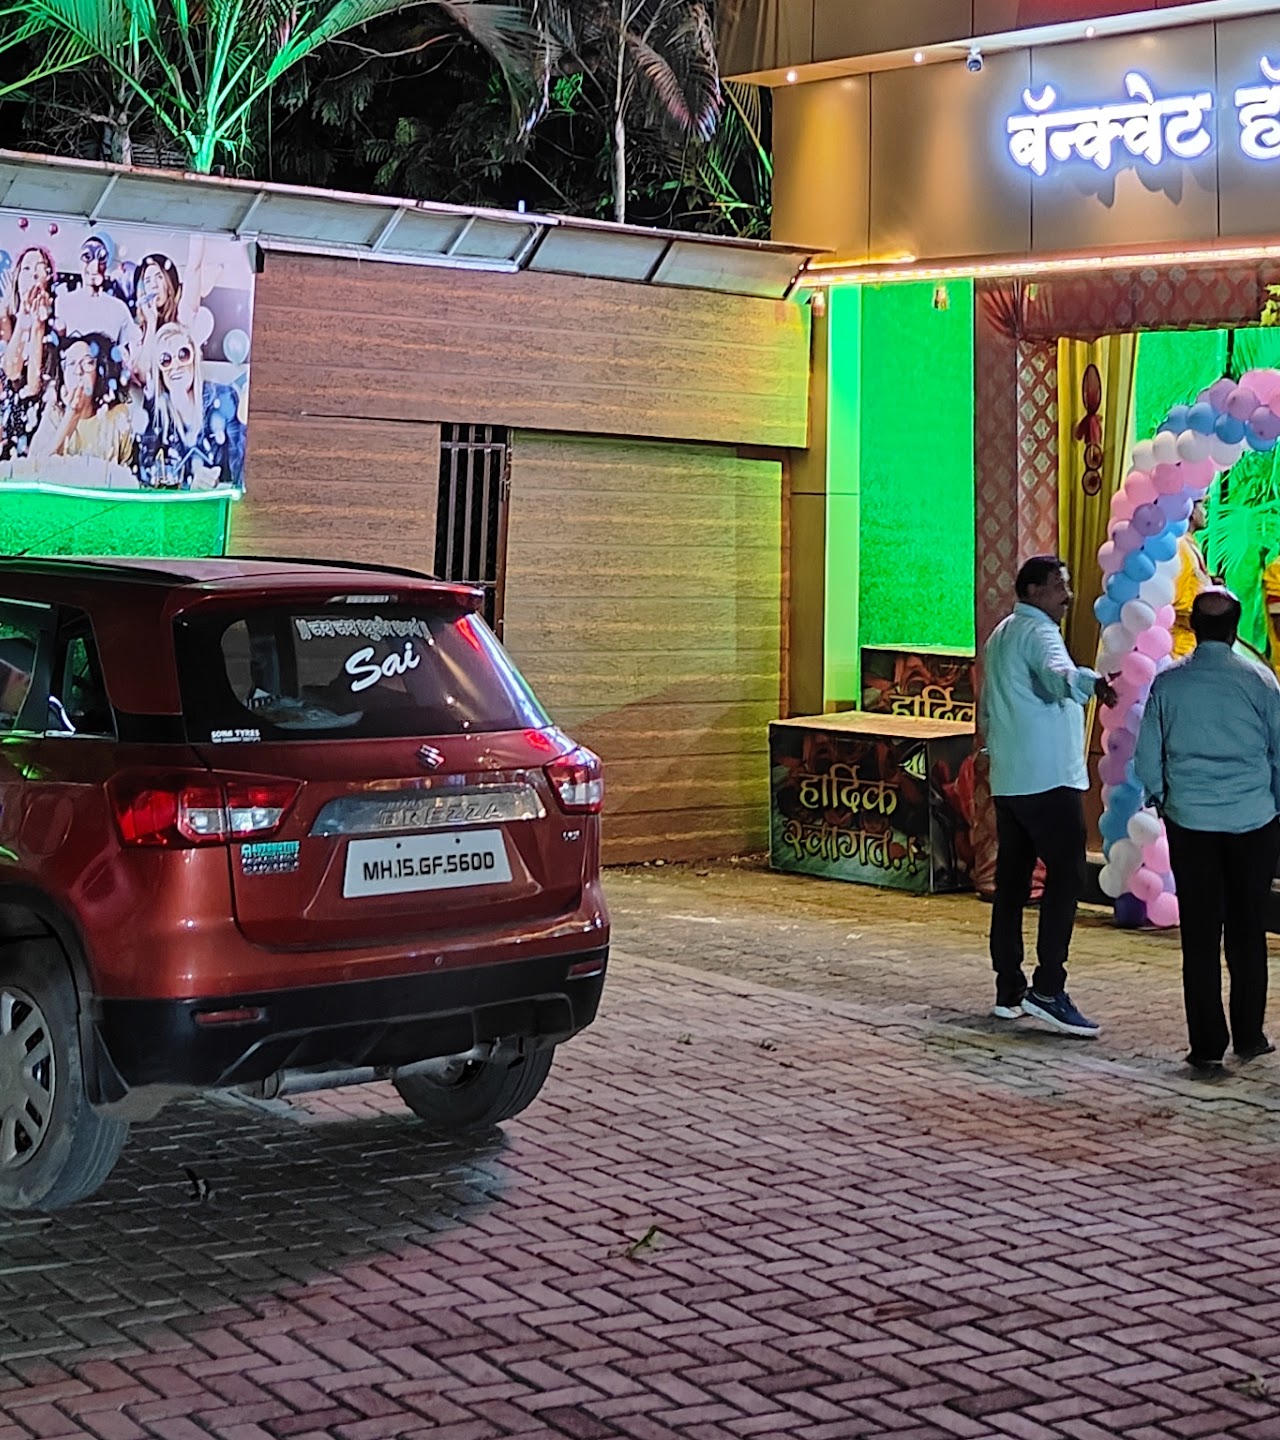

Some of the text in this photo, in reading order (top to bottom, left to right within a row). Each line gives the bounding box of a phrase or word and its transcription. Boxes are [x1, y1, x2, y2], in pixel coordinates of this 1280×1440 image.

[345, 641, 420, 692] Sai
[799, 763, 899, 815] हार्दिक
[363, 851, 495, 882] MH.15.GF.5600
